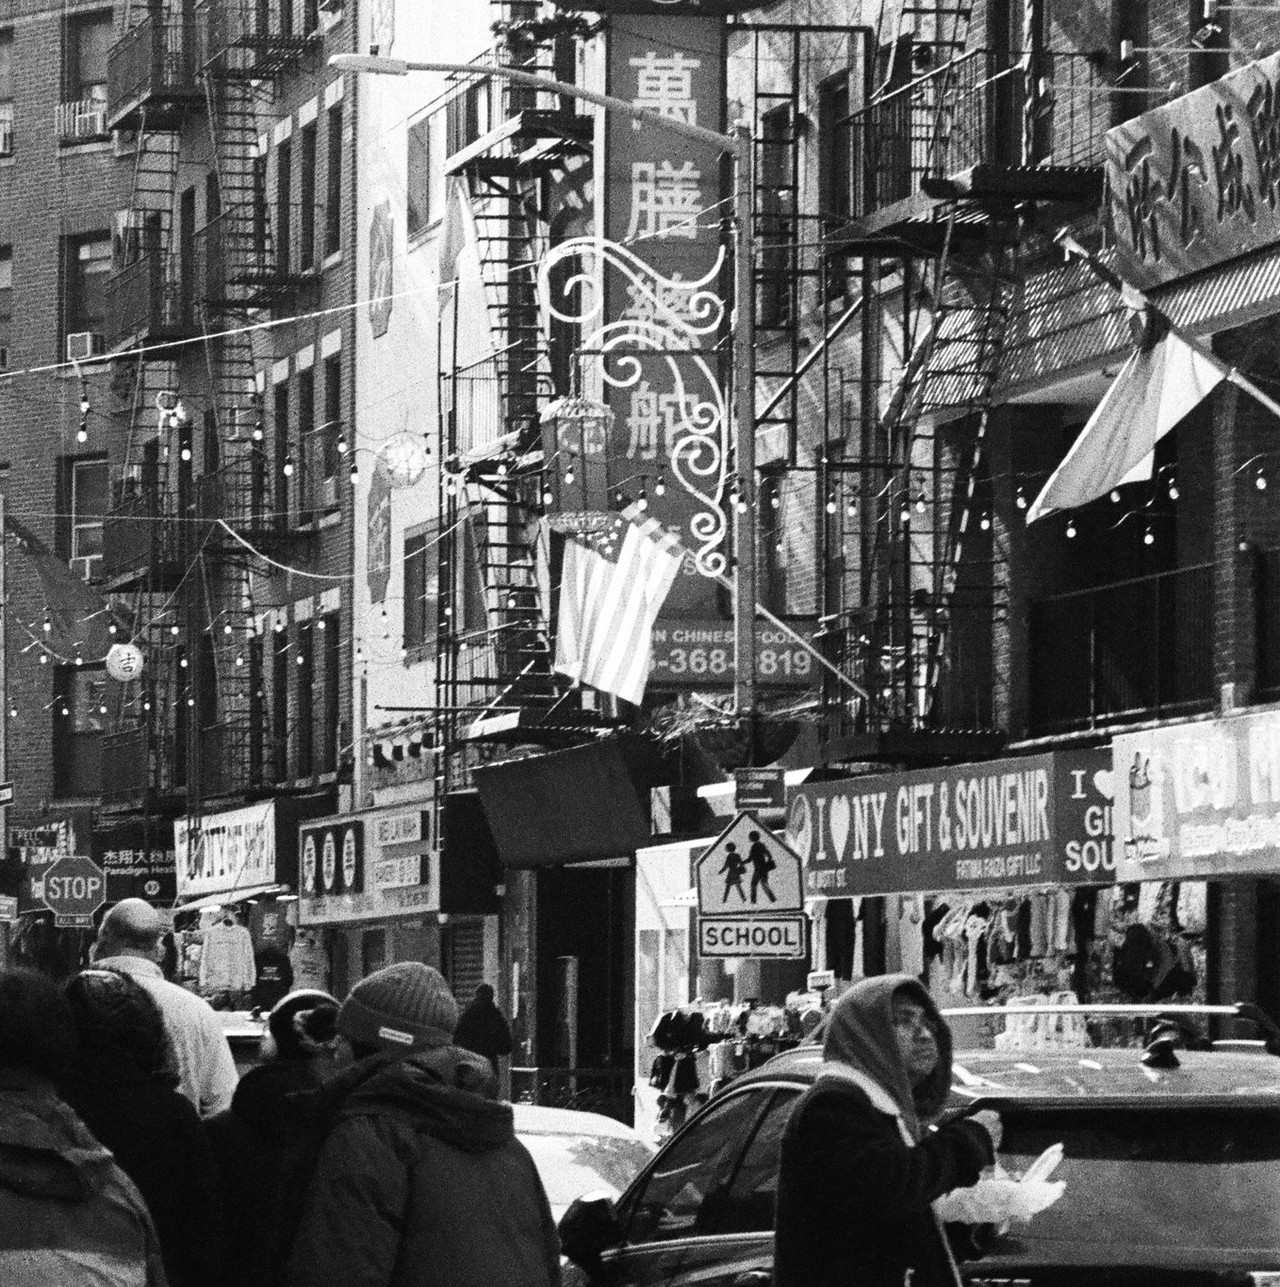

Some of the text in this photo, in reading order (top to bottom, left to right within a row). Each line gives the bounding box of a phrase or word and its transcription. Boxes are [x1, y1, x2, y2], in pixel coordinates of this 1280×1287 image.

[672, 629, 736, 644] CHINES
[816, 768, 1051, 861] I NY GIFT & SOUVENIR
[48, 876, 102, 900] STOP
[705, 926, 798, 948] SCHOOL
